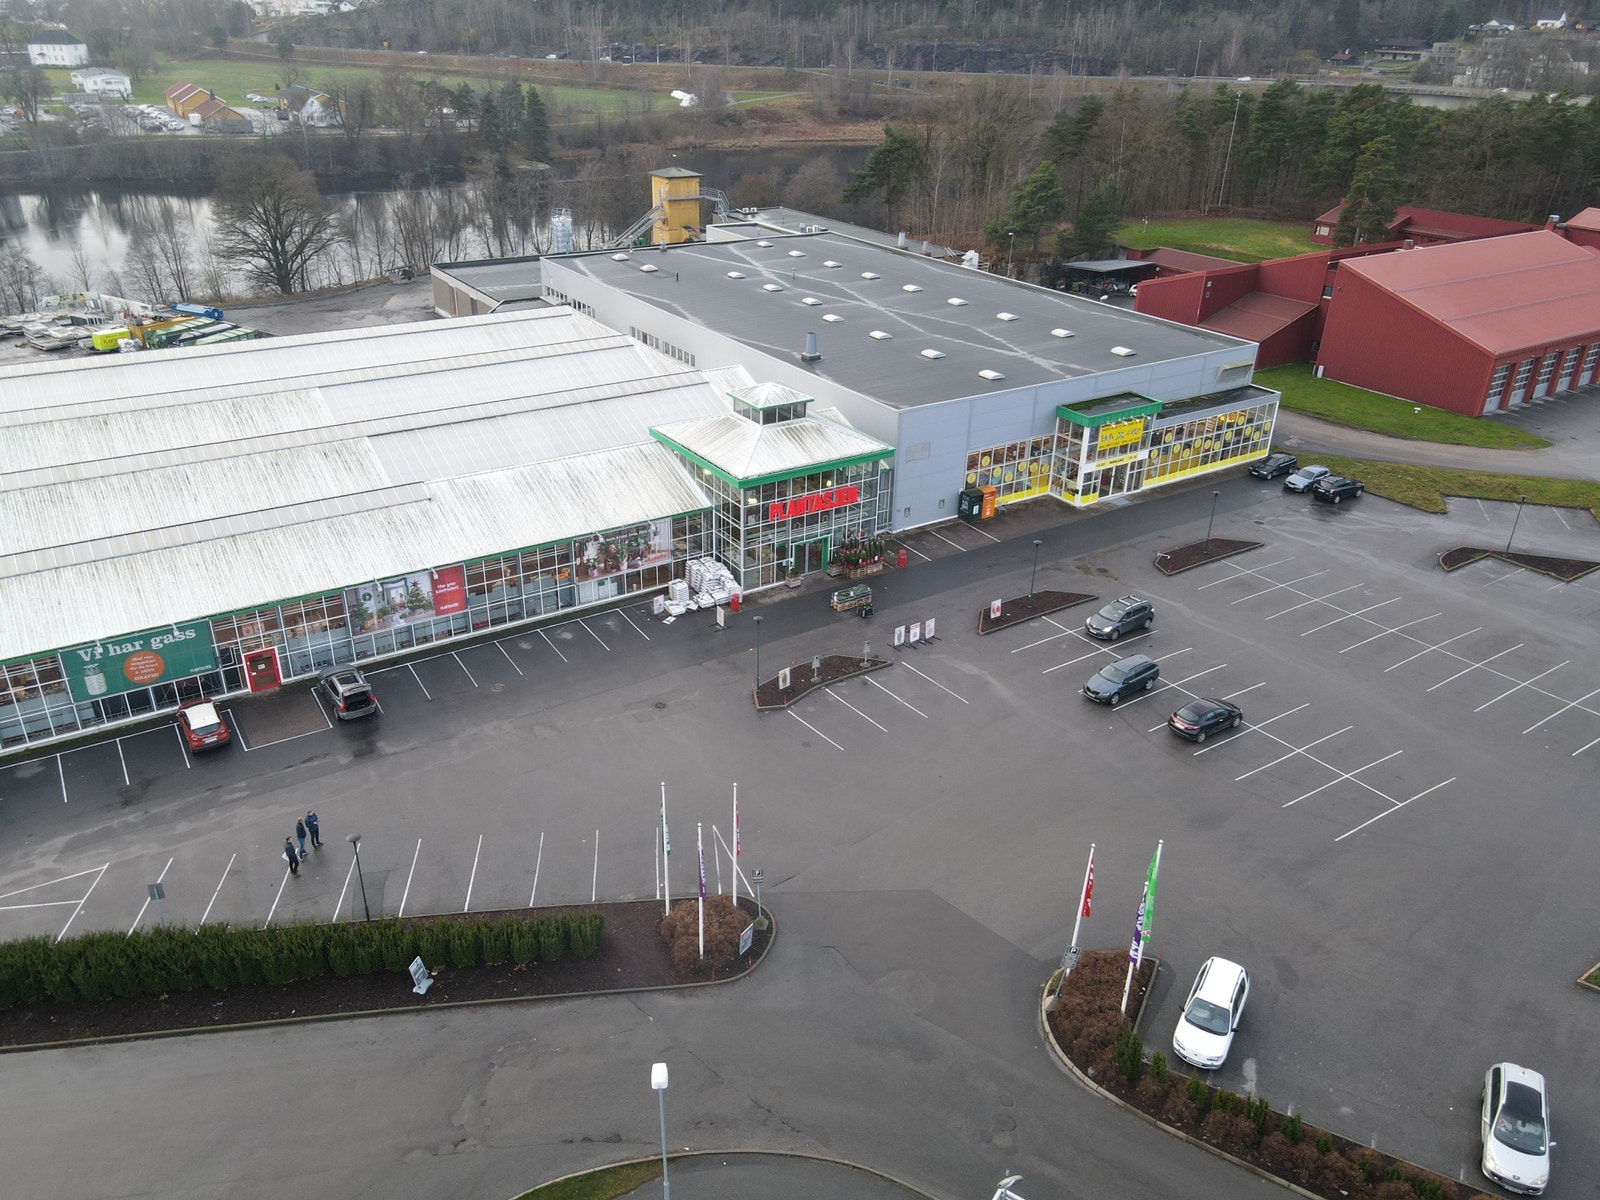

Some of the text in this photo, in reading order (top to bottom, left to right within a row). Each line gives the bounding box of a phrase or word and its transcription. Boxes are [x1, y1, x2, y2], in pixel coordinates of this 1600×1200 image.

[769, 485, 860, 522] PLANTASJEN
[77, 628, 196, 662] Vi har gass
